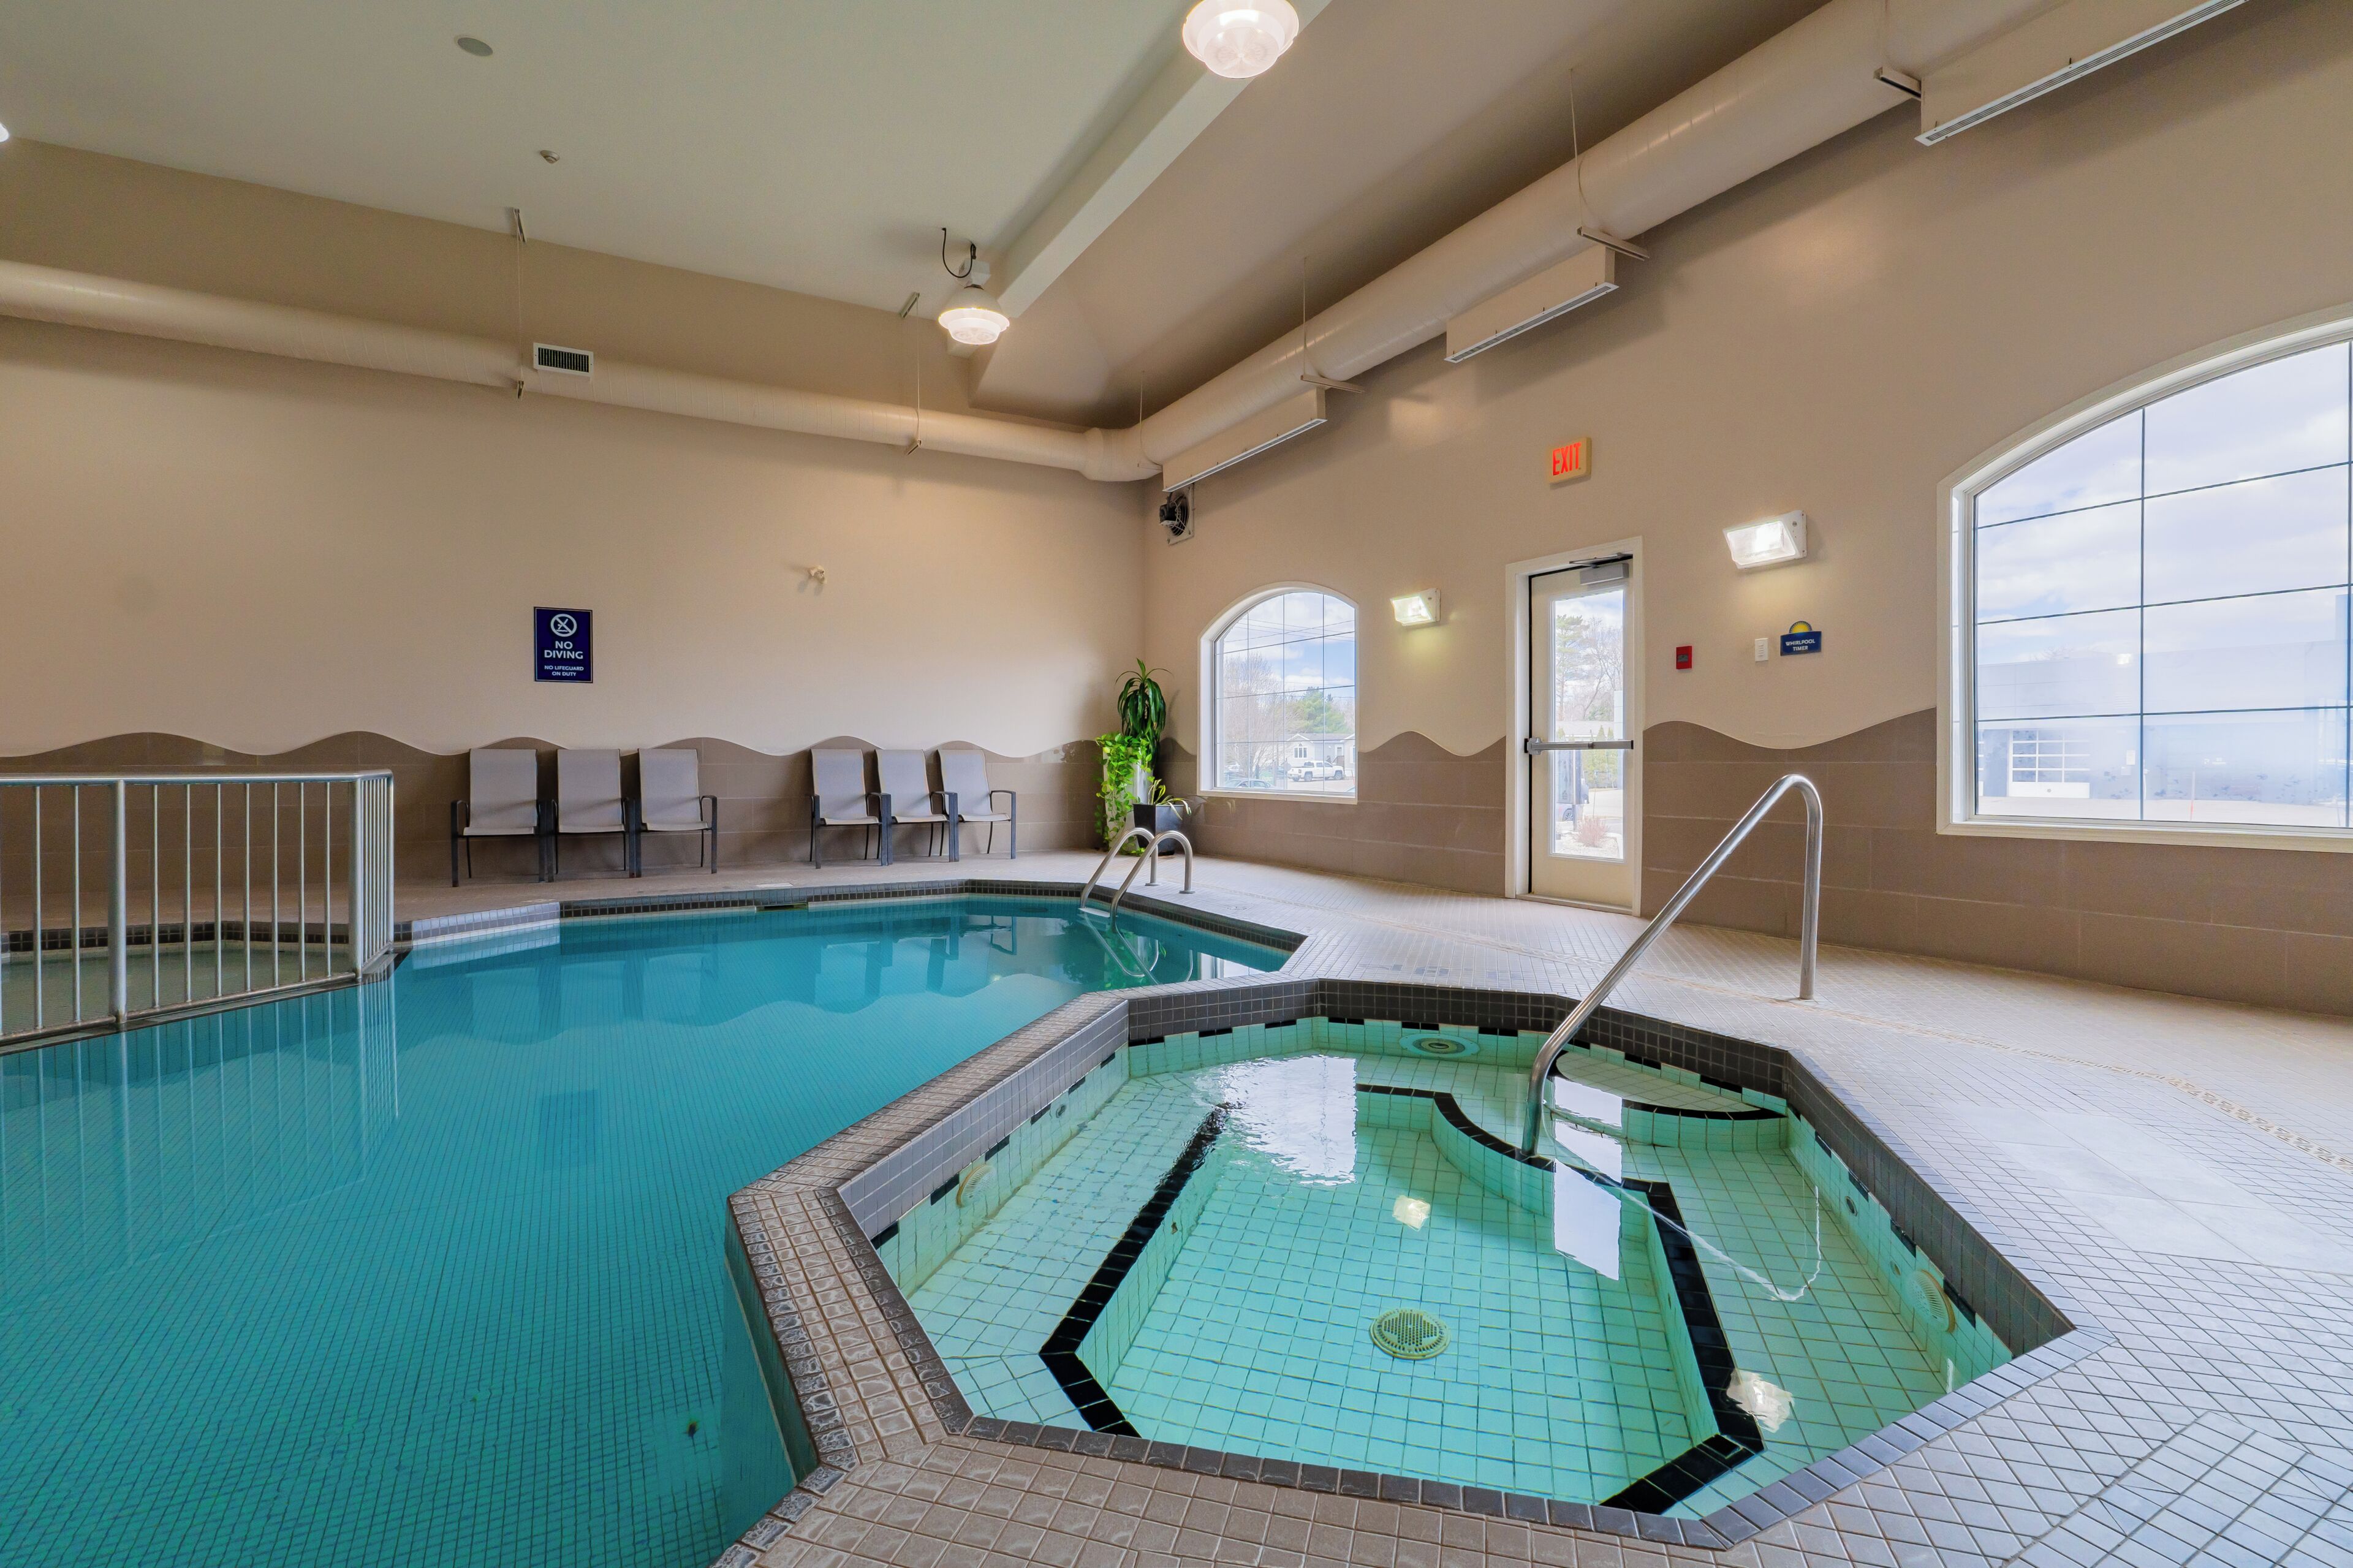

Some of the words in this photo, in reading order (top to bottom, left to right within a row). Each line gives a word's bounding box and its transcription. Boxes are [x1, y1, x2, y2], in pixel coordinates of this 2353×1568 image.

[1553, 442, 1581, 475] EXIT
[555, 640, 573, 650] NO
[544, 650, 583, 659] DIVING
